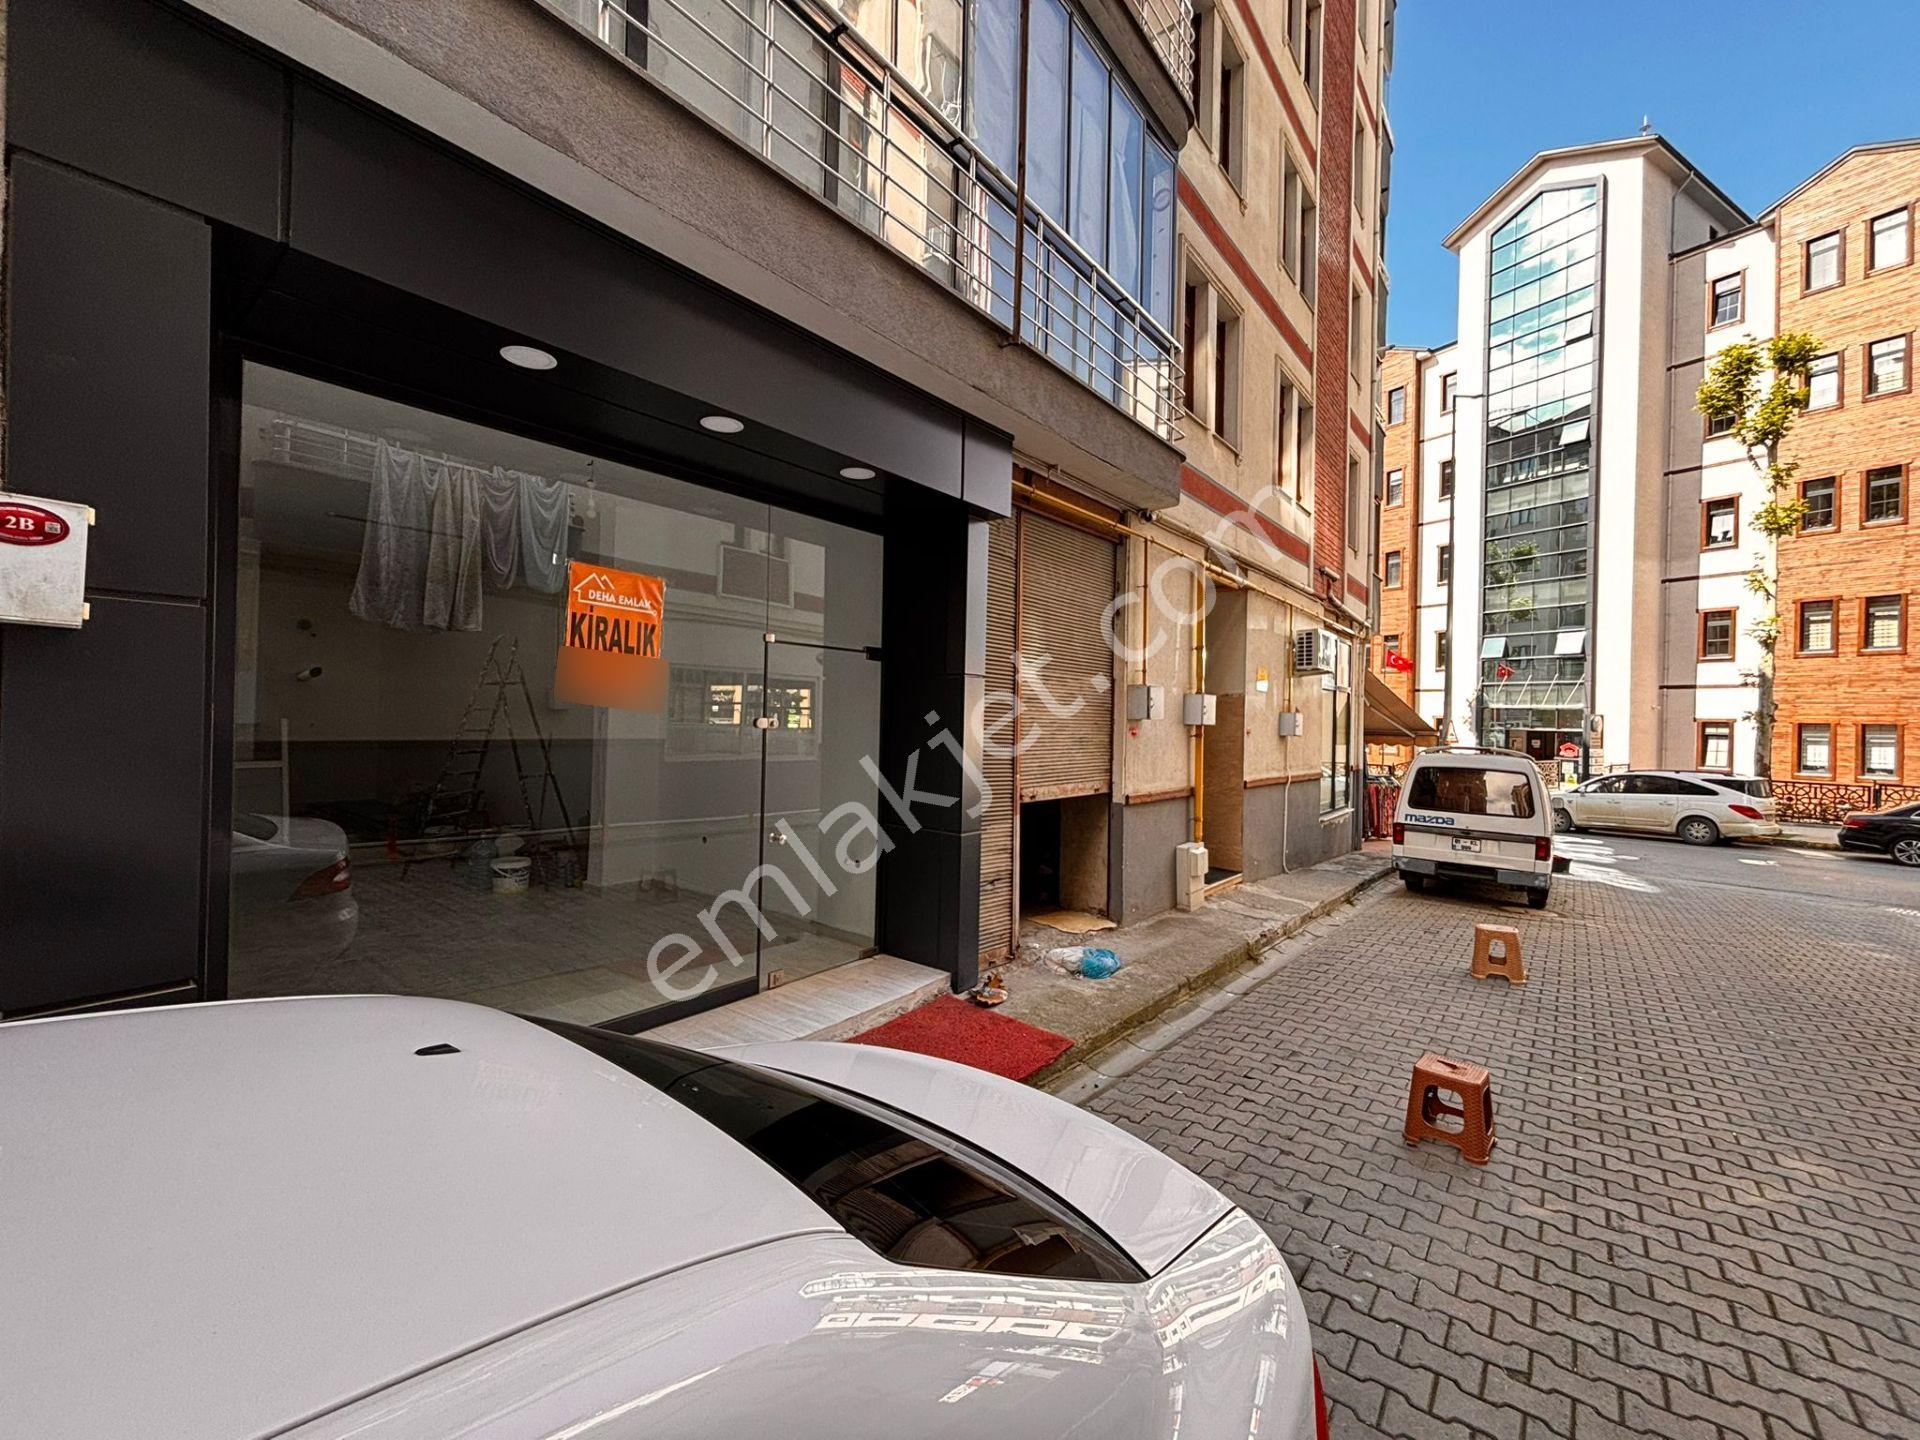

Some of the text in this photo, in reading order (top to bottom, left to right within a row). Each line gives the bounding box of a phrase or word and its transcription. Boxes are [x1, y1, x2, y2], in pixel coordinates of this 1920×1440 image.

[5, 516, 35, 530] 2B
[588, 589, 652, 609] DEHA EMLAK
[570, 605, 657, 657] KİRALIK
